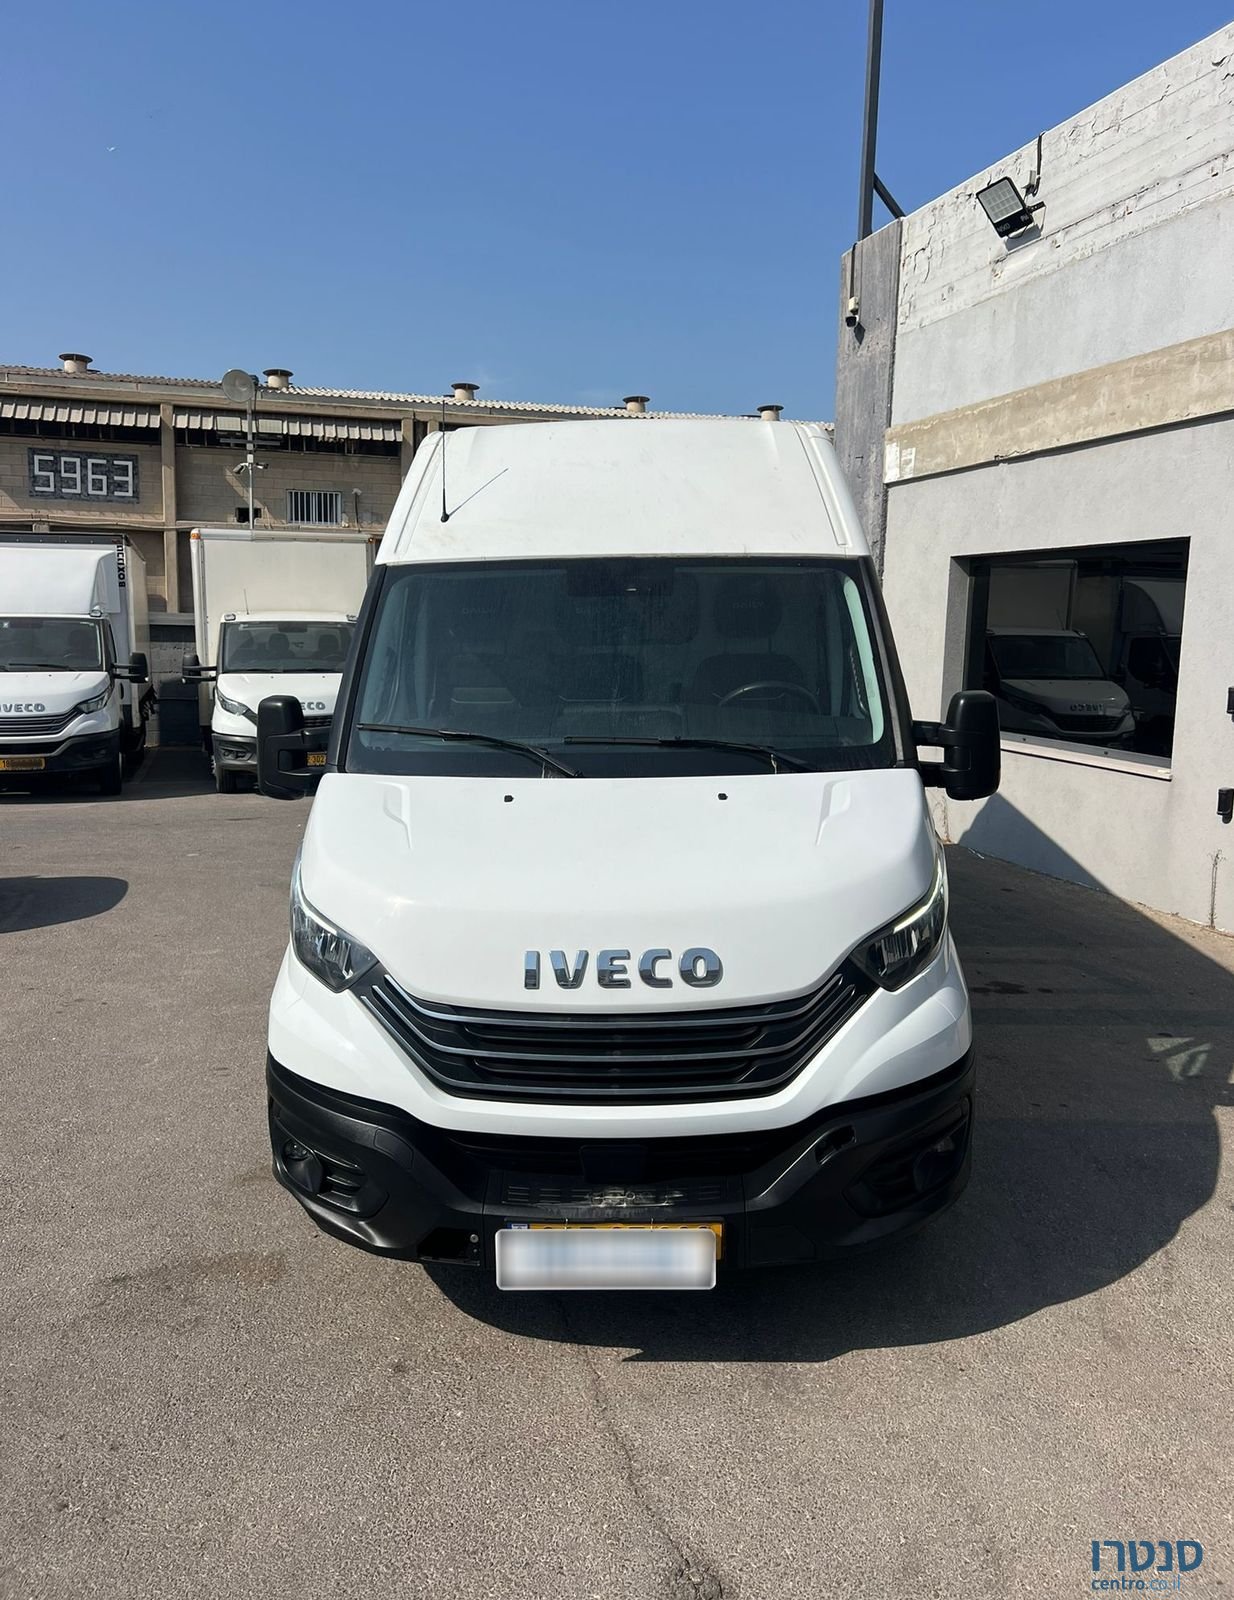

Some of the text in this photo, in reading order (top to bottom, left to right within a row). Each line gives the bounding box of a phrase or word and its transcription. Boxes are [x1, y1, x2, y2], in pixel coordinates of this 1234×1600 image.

[34, 455, 133, 496] 5963
[0, 703, 46, 713] VECO
[301, 702, 326, 711] ECO
[524, 947, 724, 990] IVECO
